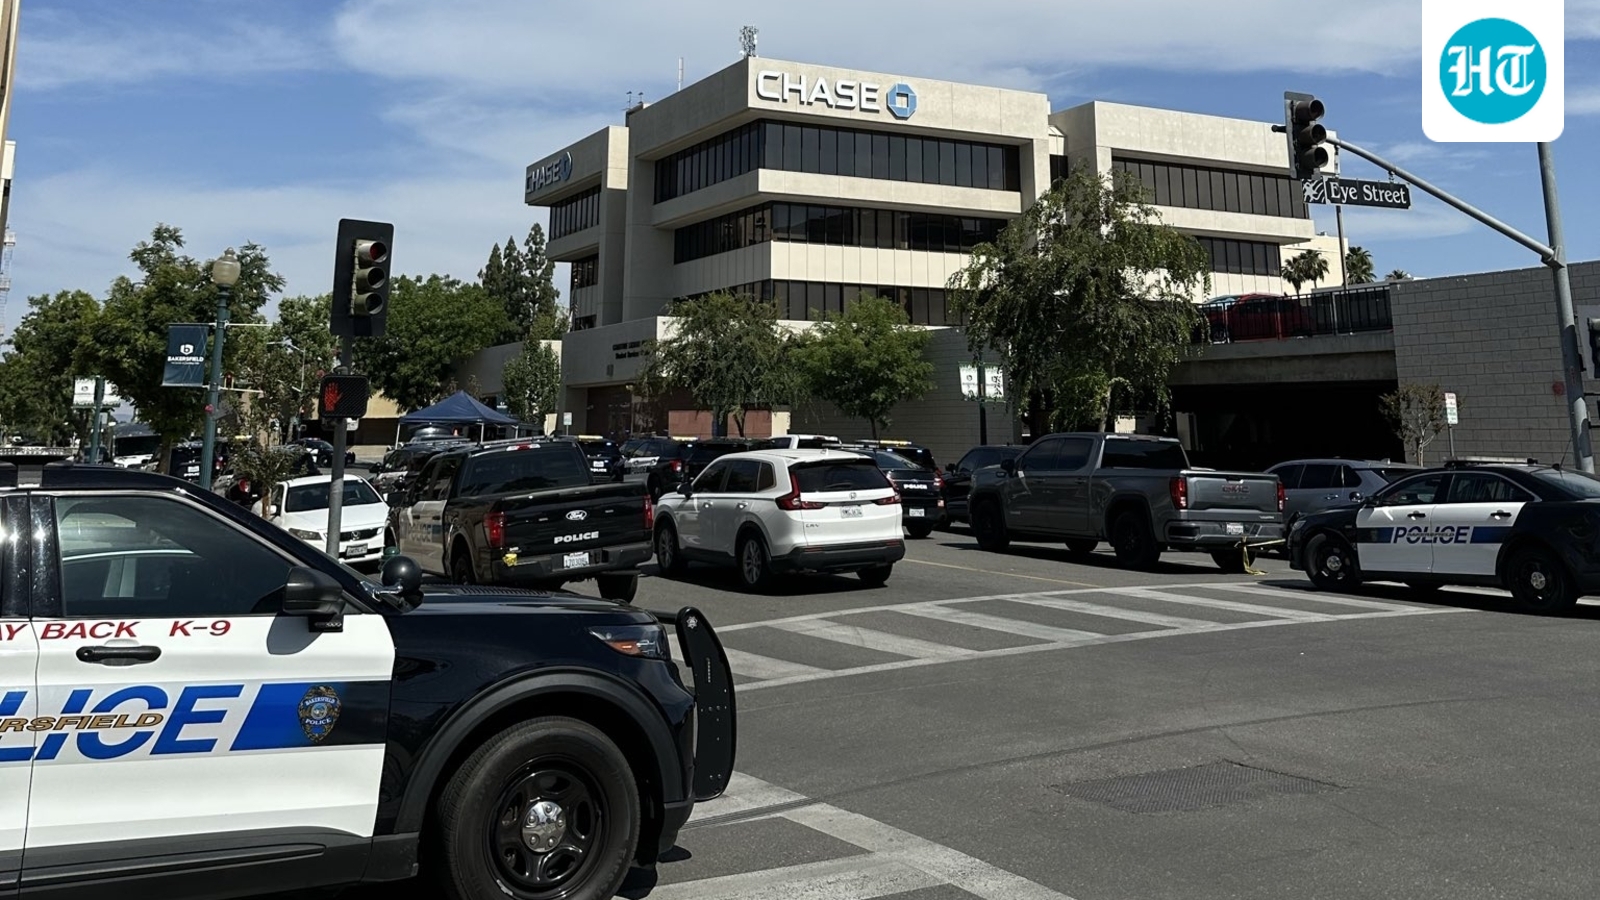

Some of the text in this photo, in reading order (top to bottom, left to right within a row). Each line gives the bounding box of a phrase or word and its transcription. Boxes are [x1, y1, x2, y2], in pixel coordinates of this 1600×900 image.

[756, 70, 880, 113] CHASE
[526, 159, 561, 194] CHASE
[1330, 181, 1407, 204] Eye Street
[553, 531, 600, 544] POLICE
[1393, 525, 1470, 545] POLICE
[0, 620, 232, 641] Y BACK K-9
[305, 696, 336, 706] BAKERSFIELD
